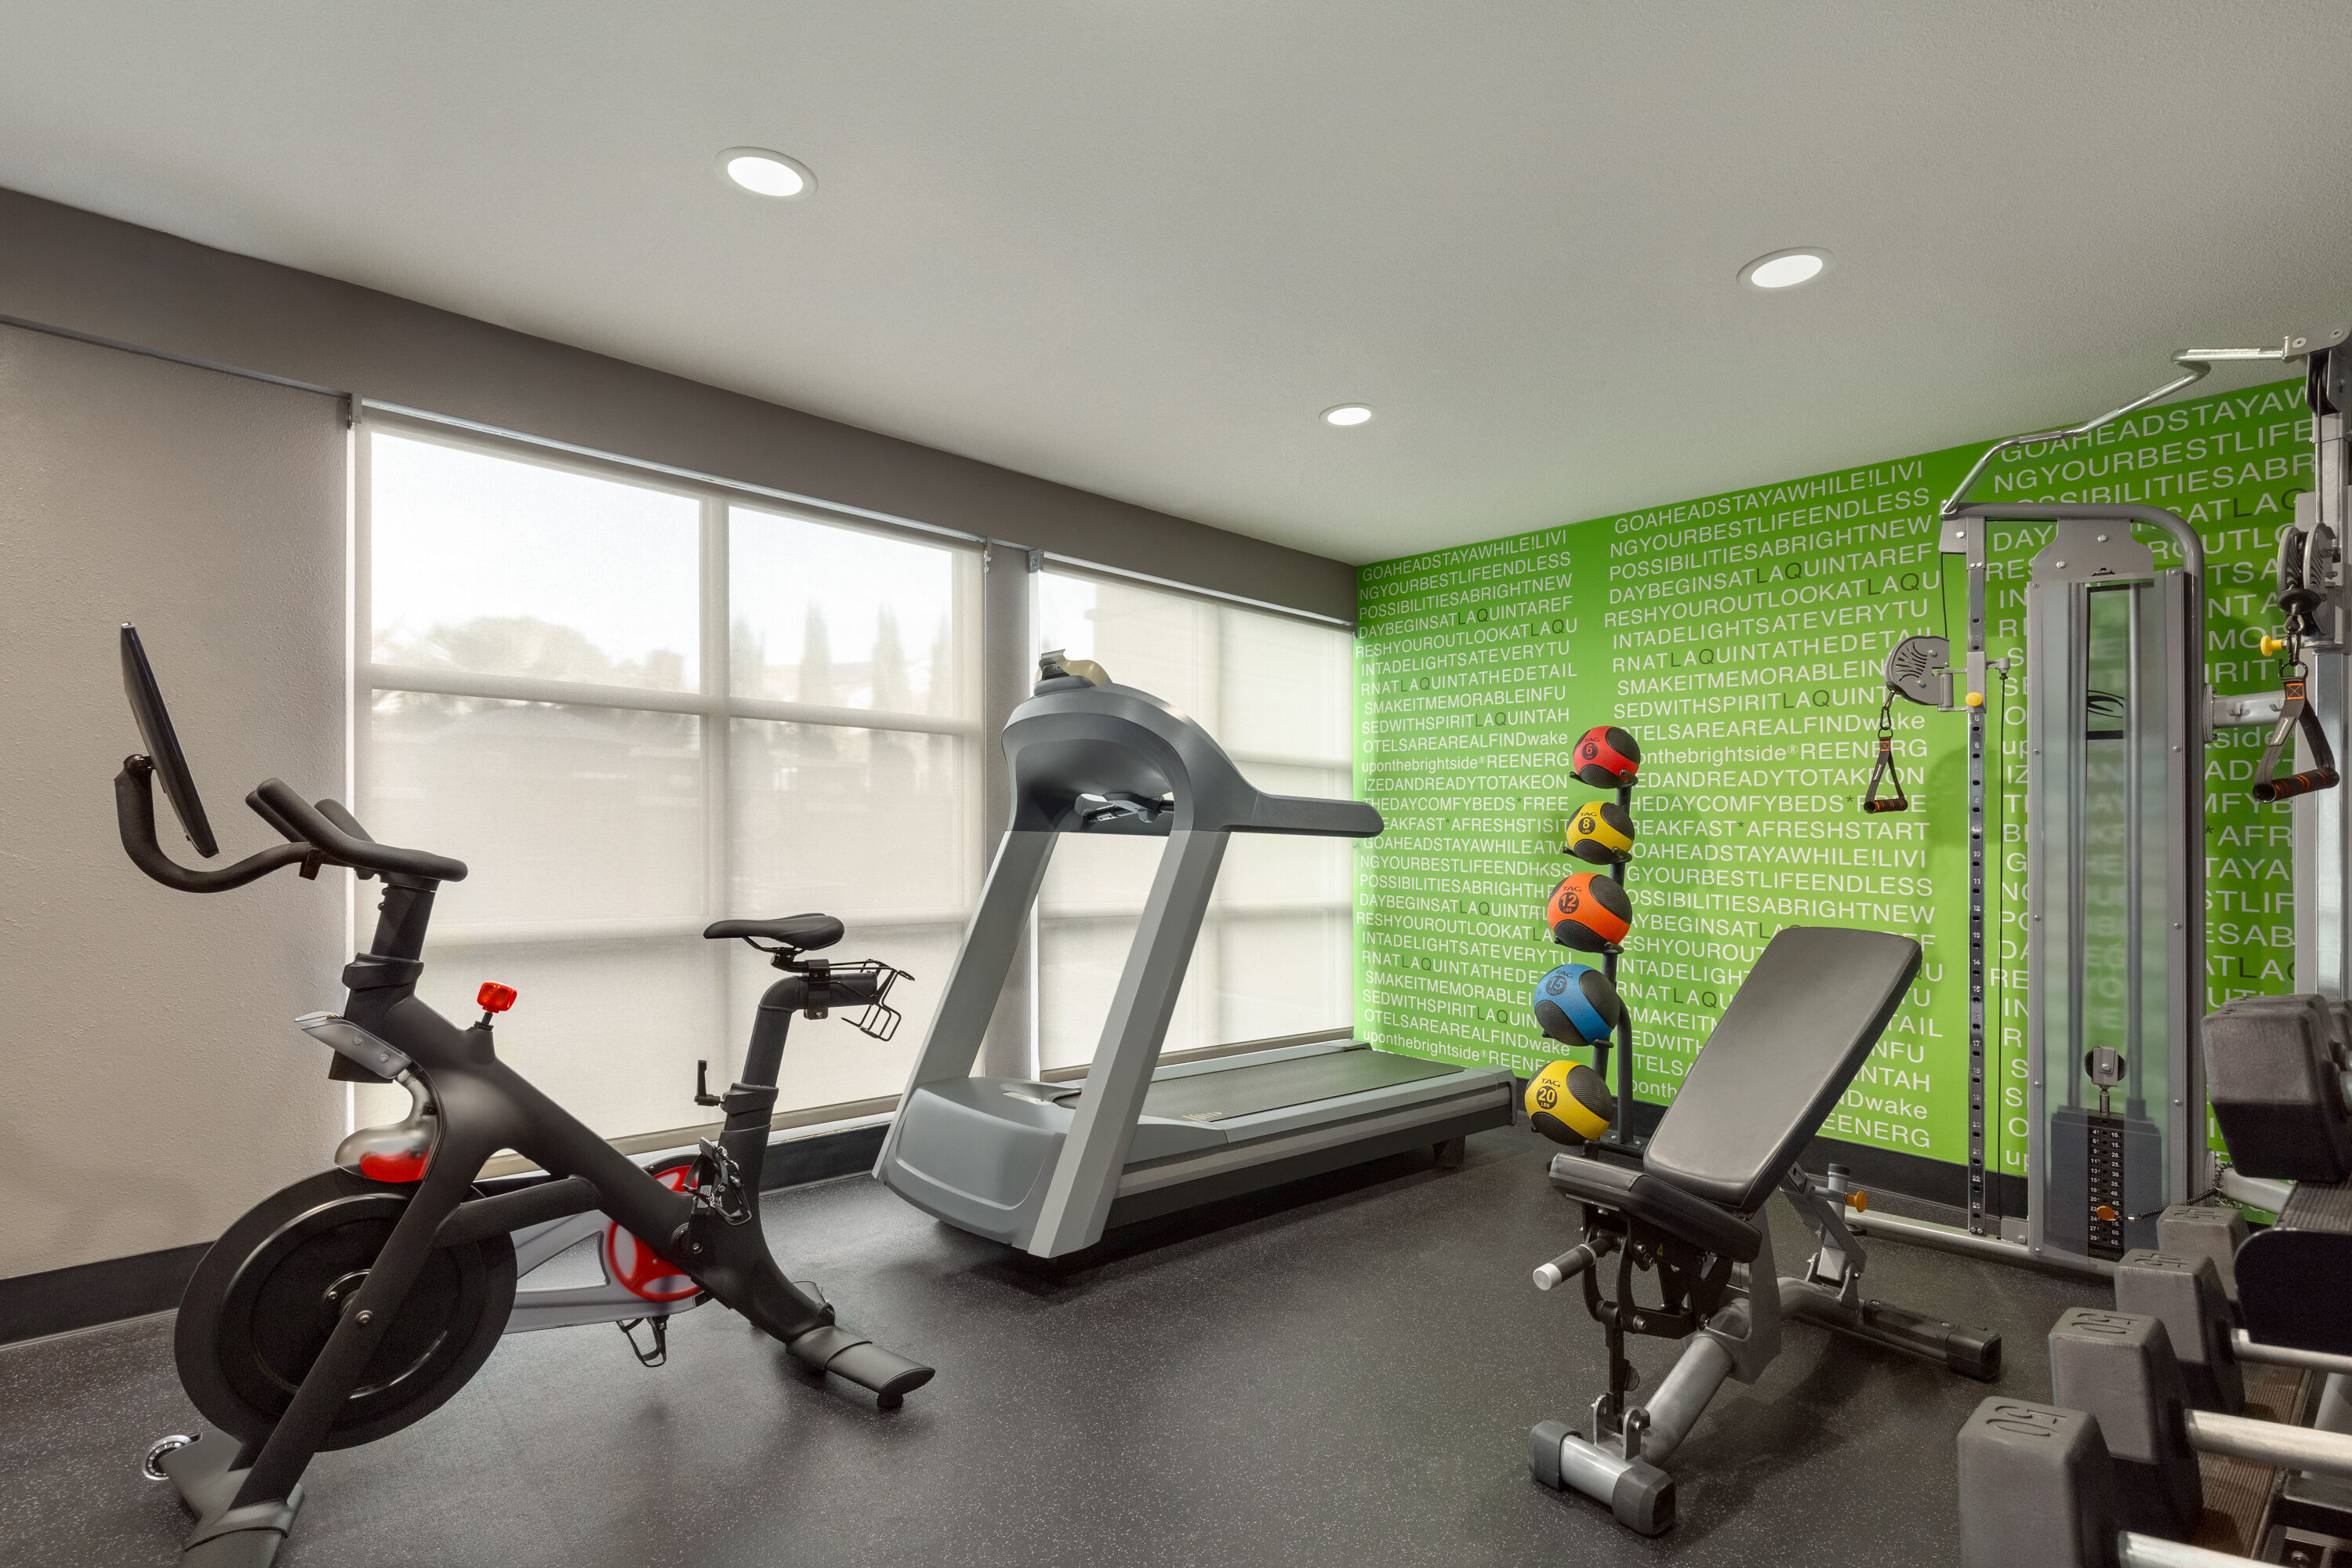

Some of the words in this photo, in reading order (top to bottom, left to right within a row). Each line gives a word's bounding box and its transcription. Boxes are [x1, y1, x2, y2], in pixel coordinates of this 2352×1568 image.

[1585, 744, 1593, 753] 6
[1582, 818, 1590, 829] 8
[1561, 895, 1577, 907] 12
[1550, 976, 1564, 989] 15
[1537, 1087, 1555, 1103] 20
